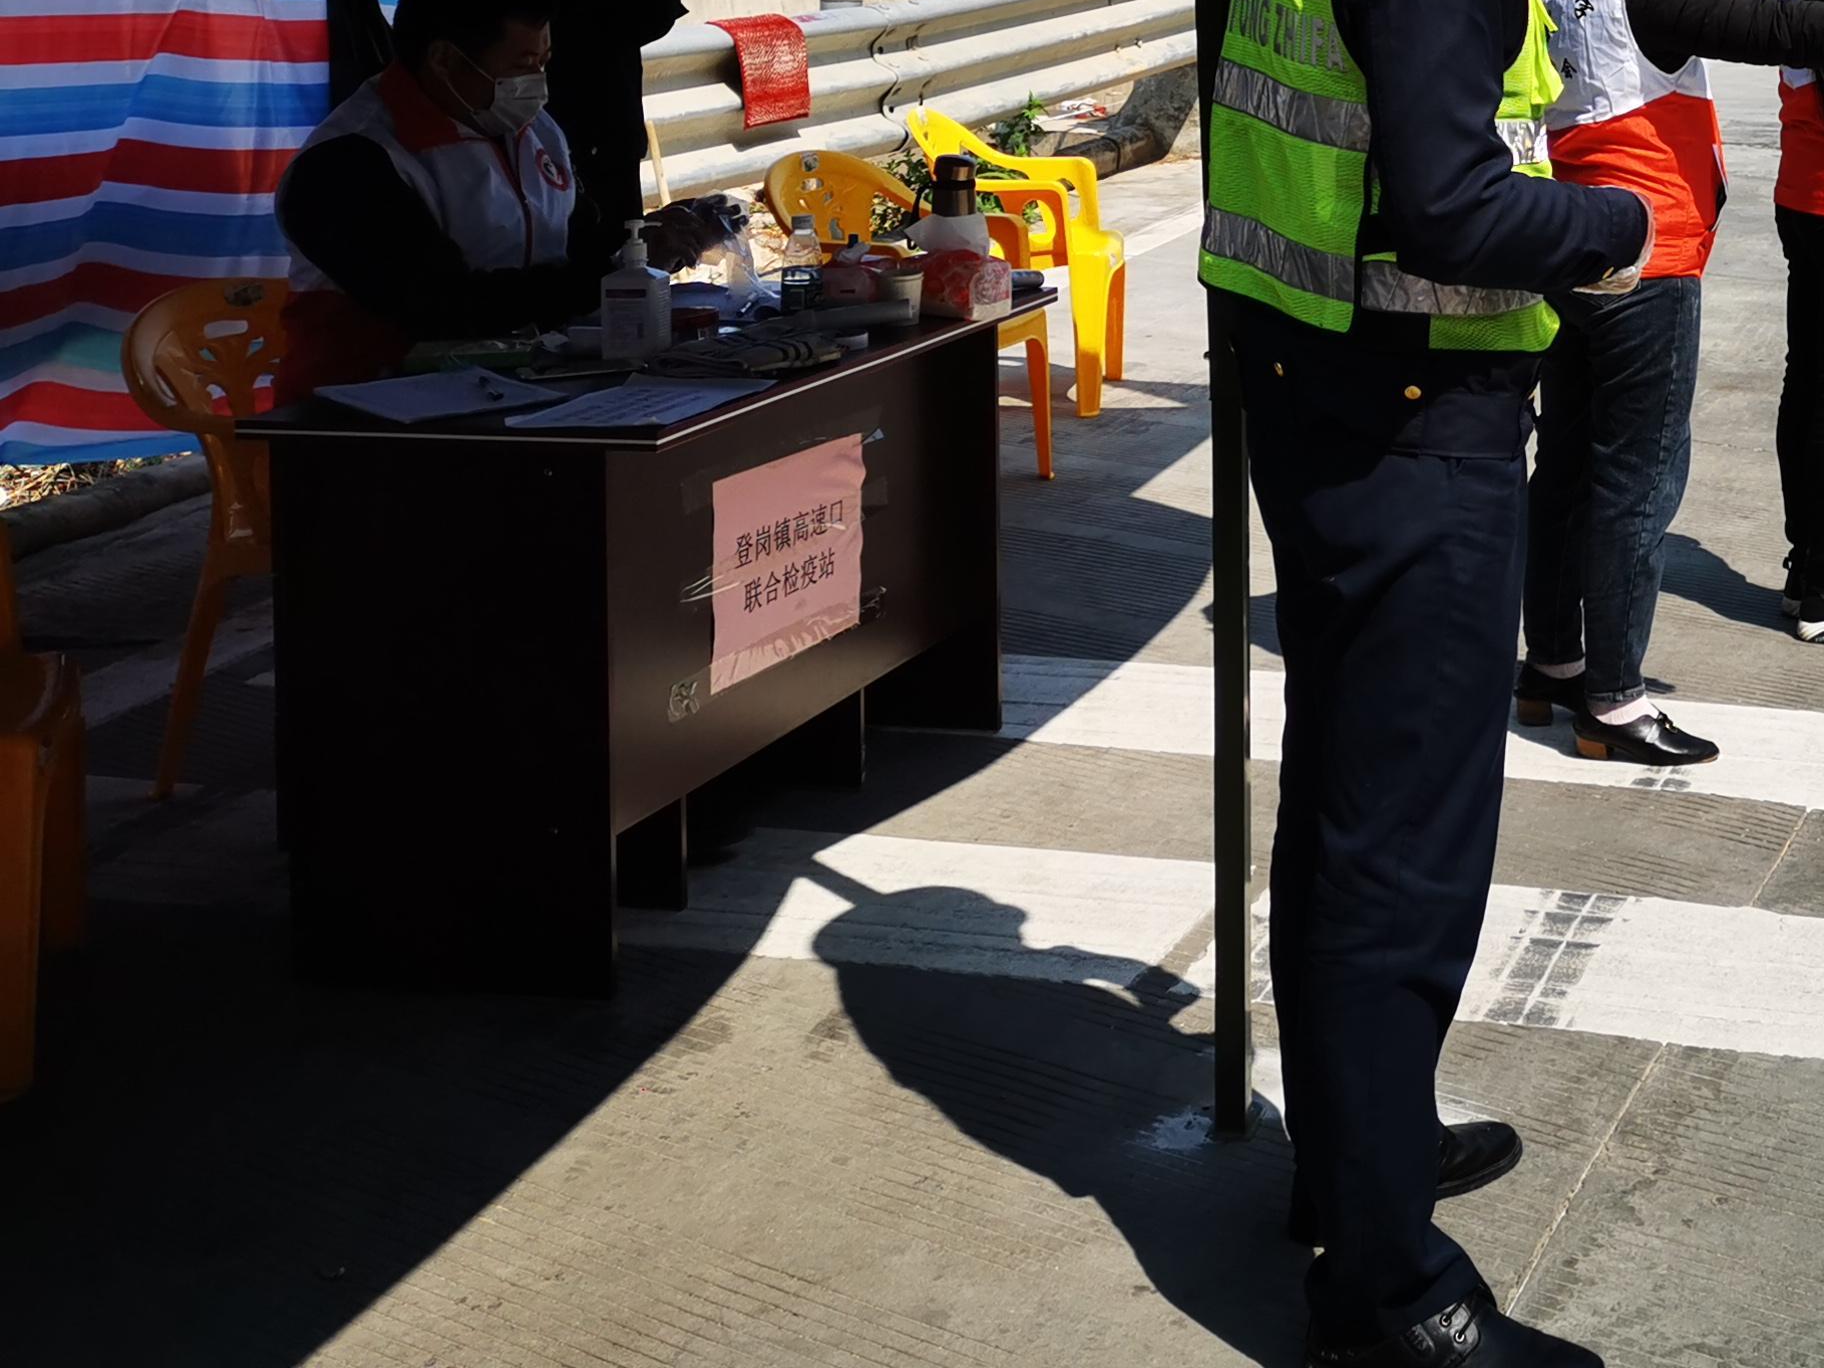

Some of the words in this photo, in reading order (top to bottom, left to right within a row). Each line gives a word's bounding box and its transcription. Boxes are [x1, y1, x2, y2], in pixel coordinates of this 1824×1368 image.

[734, 499, 844, 570] 登岗镇高速口
[743, 547, 836, 614] 联合检疫站
